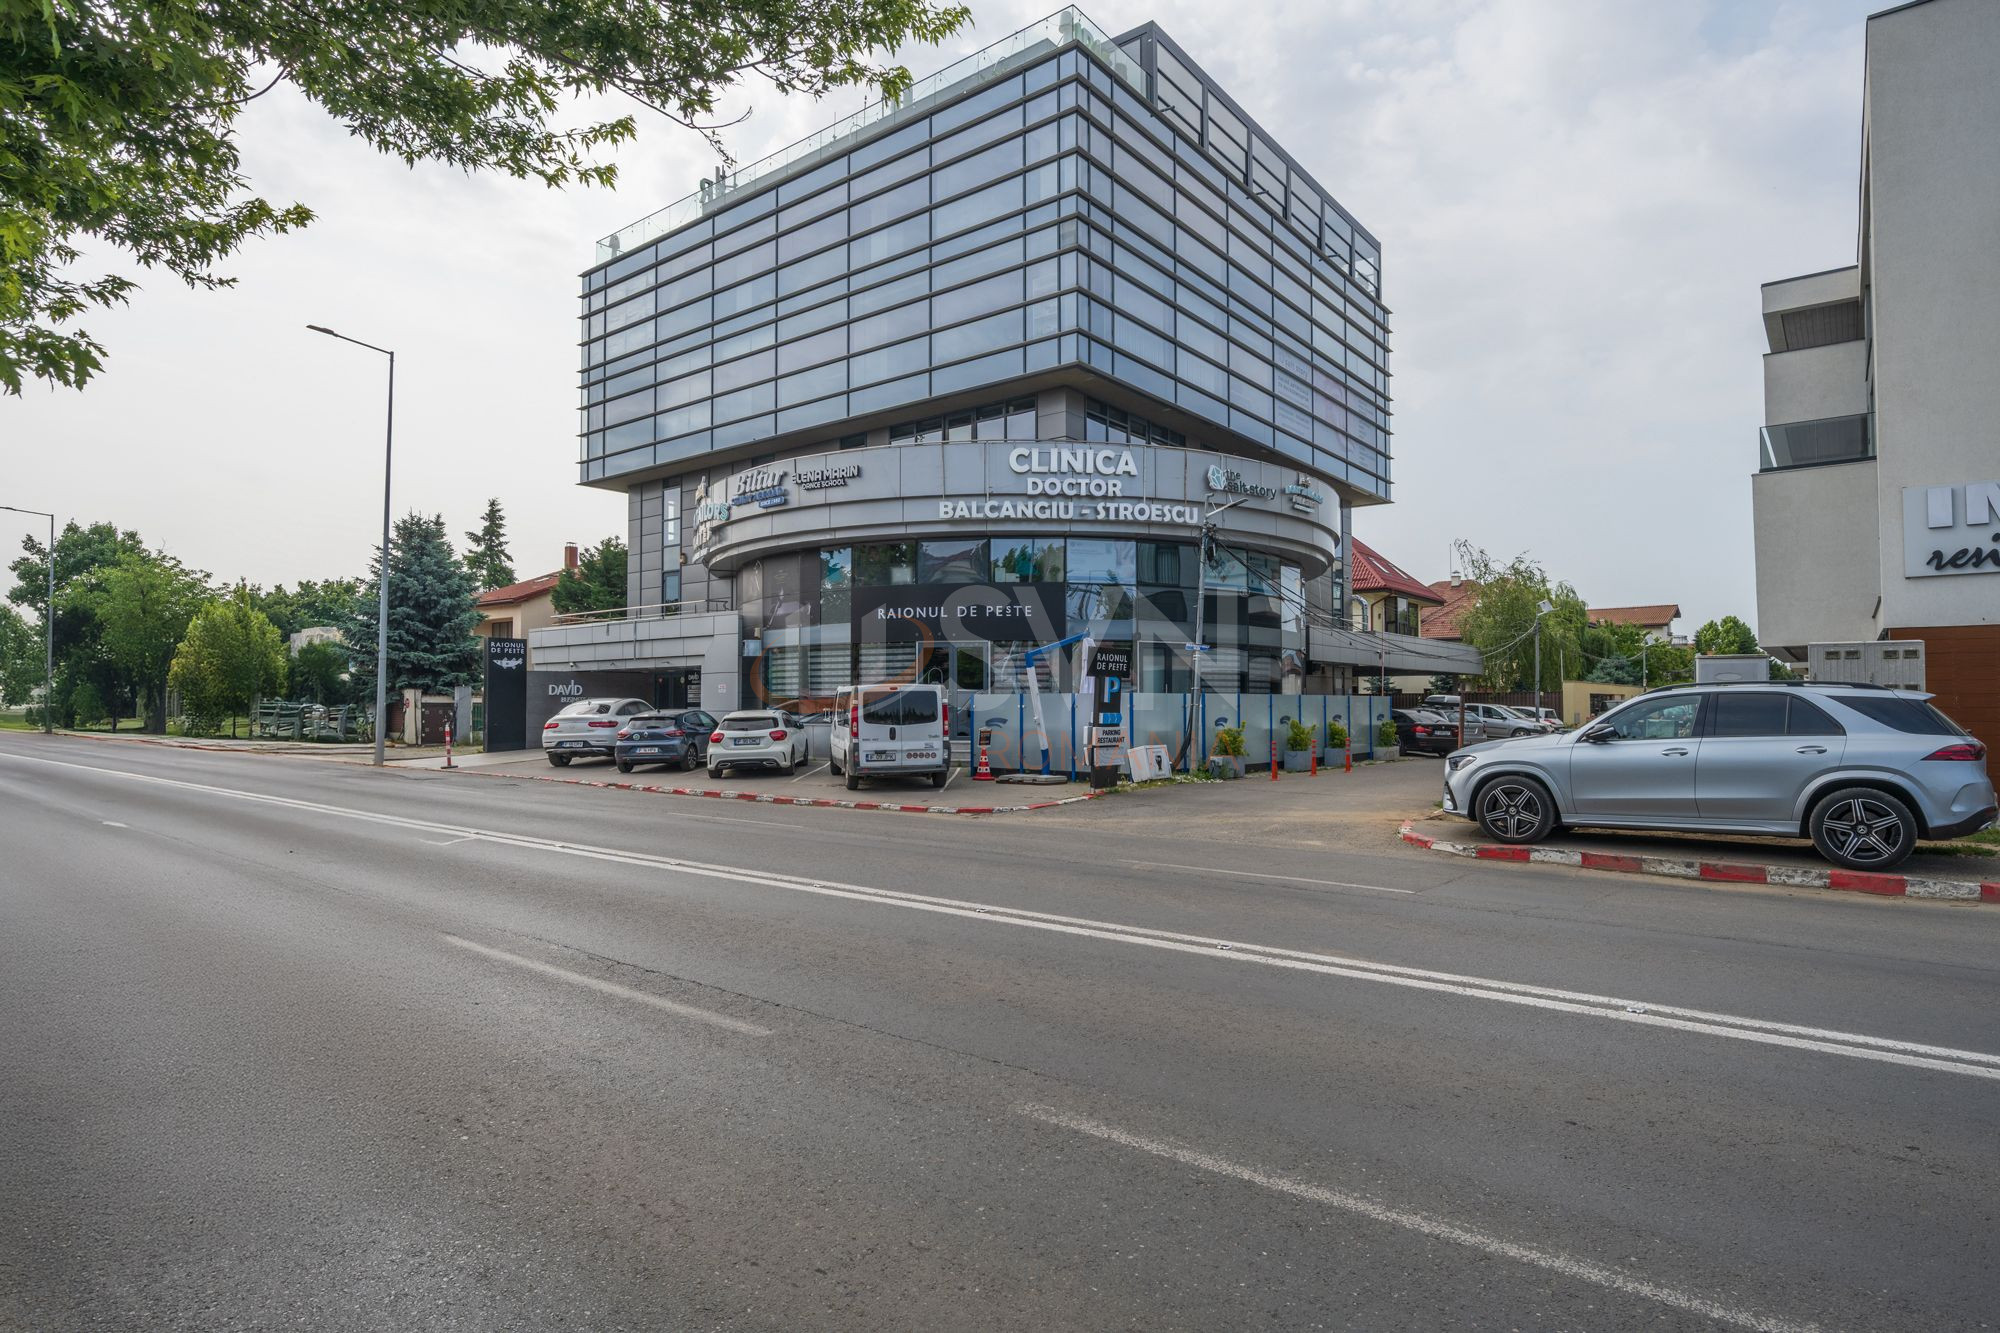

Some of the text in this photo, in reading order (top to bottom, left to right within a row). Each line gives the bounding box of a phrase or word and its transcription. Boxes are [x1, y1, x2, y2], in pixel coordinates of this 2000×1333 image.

[1009, 448, 1138, 476] CLINICA
[792, 465, 858, 484] ELENA MARIN
[1226, 469, 1241, 481] the
[736, 470, 785, 495] Biltur
[802, 478, 845, 490] DANCE SCHOOL
[1027, 478, 1122, 497] DOCTOR
[939, 501, 1074, 520] BALCANGIU
[1096, 502, 1198, 524] STROESCU
[877, 606, 948, 619] RAIONUL
[957, 606, 978, 617] DE
[490, 641, 525, 649] RAIONUL
[1096, 652, 1128, 663] RAIONUL
[1096, 662, 1106, 670] DE
[1104, 675, 1121, 704] P
[1097, 736, 1125, 744] RESTAURANT
